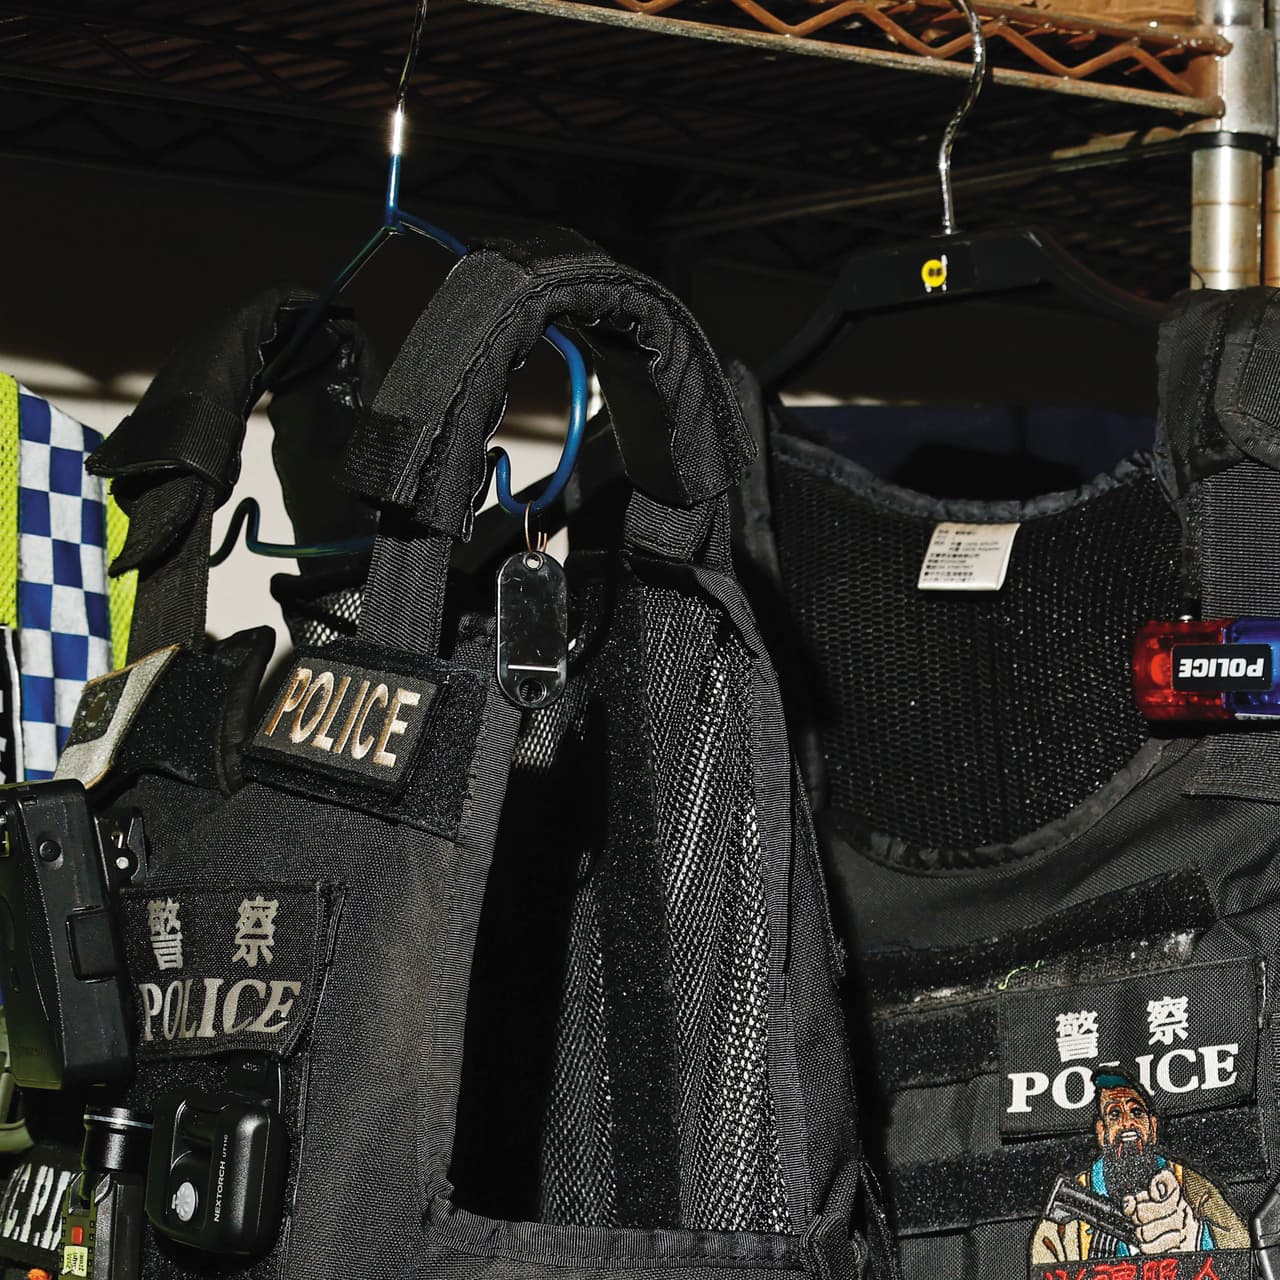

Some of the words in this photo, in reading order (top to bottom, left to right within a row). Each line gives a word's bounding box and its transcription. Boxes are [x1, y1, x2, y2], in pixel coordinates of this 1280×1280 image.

[1178, 658, 1265, 678] POLICE
[264, 666, 420, 767] POLICE
[147, 896, 279, 970] 警察
[138, 978, 302, 1041] POLICE
[1056, 997, 1189, 1062] 警察
[1006, 1043, 1238, 1113] POICE
[213, 1160, 226, 1223] NEXTORCH
